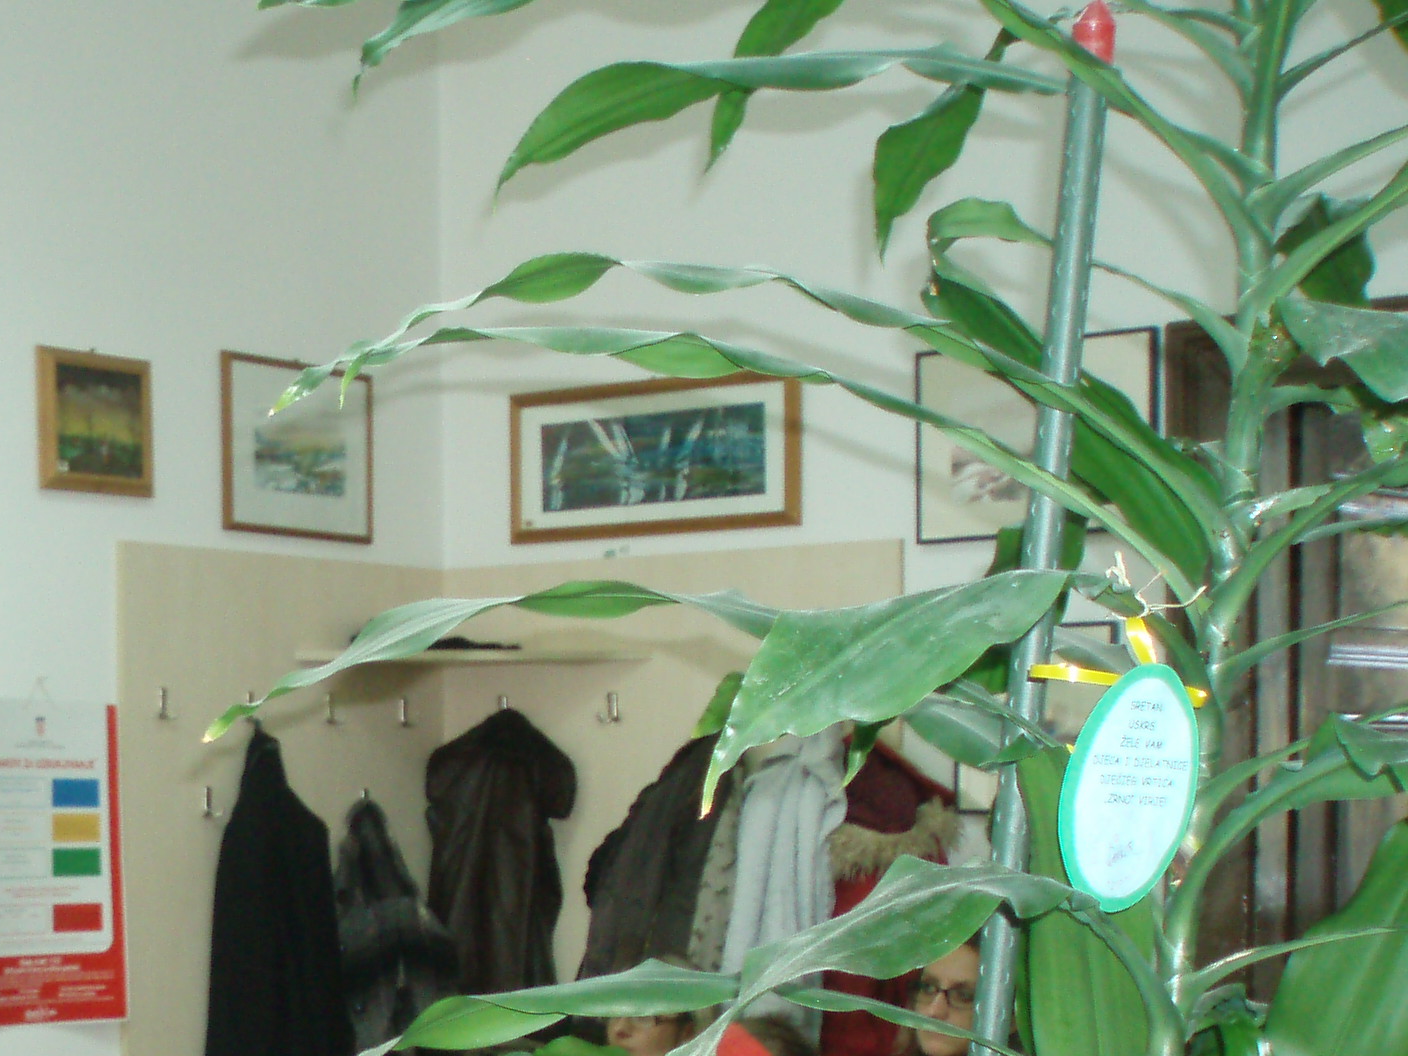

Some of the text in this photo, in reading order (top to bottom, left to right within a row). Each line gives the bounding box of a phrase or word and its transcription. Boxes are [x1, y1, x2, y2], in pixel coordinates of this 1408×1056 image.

[1131, 701, 1163, 712] SRETAN
[1128, 720, 1156, 731] USKRS
[1145, 740, 1163, 749] VAM
